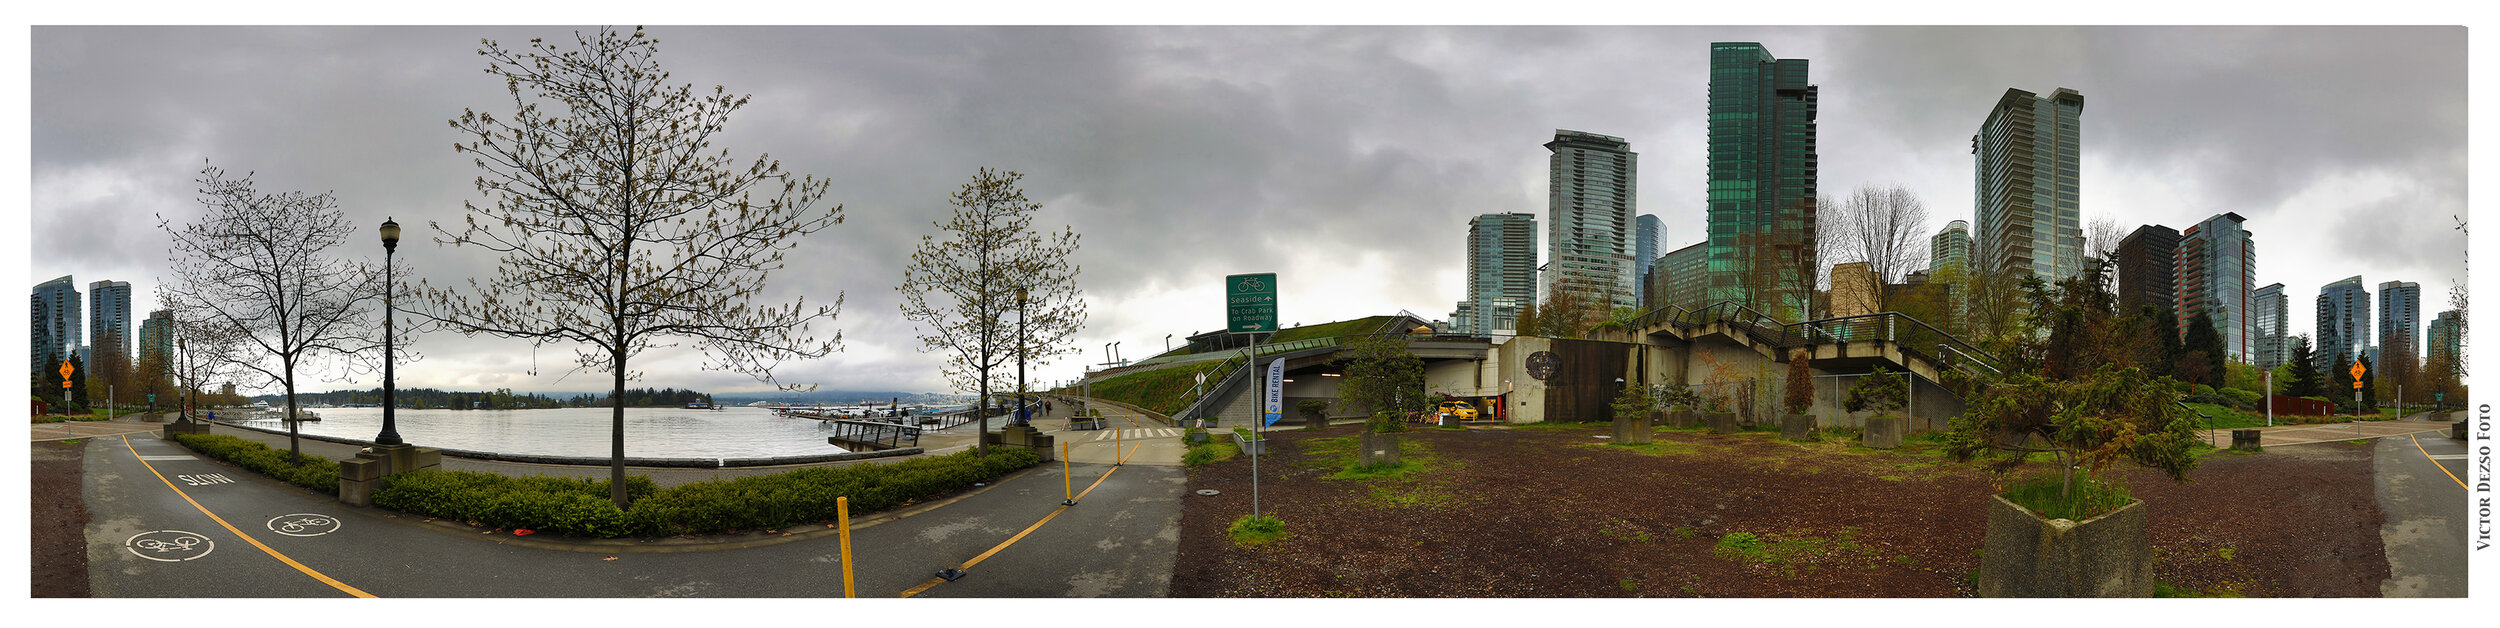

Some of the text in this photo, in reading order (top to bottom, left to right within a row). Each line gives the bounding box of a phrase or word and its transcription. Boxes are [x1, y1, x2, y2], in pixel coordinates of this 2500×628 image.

[1231, 296, 1262, 304] Seaside
[1271, 365, 1281, 403] BIKE RENTAL
[177, 473, 235, 486] SLOW
